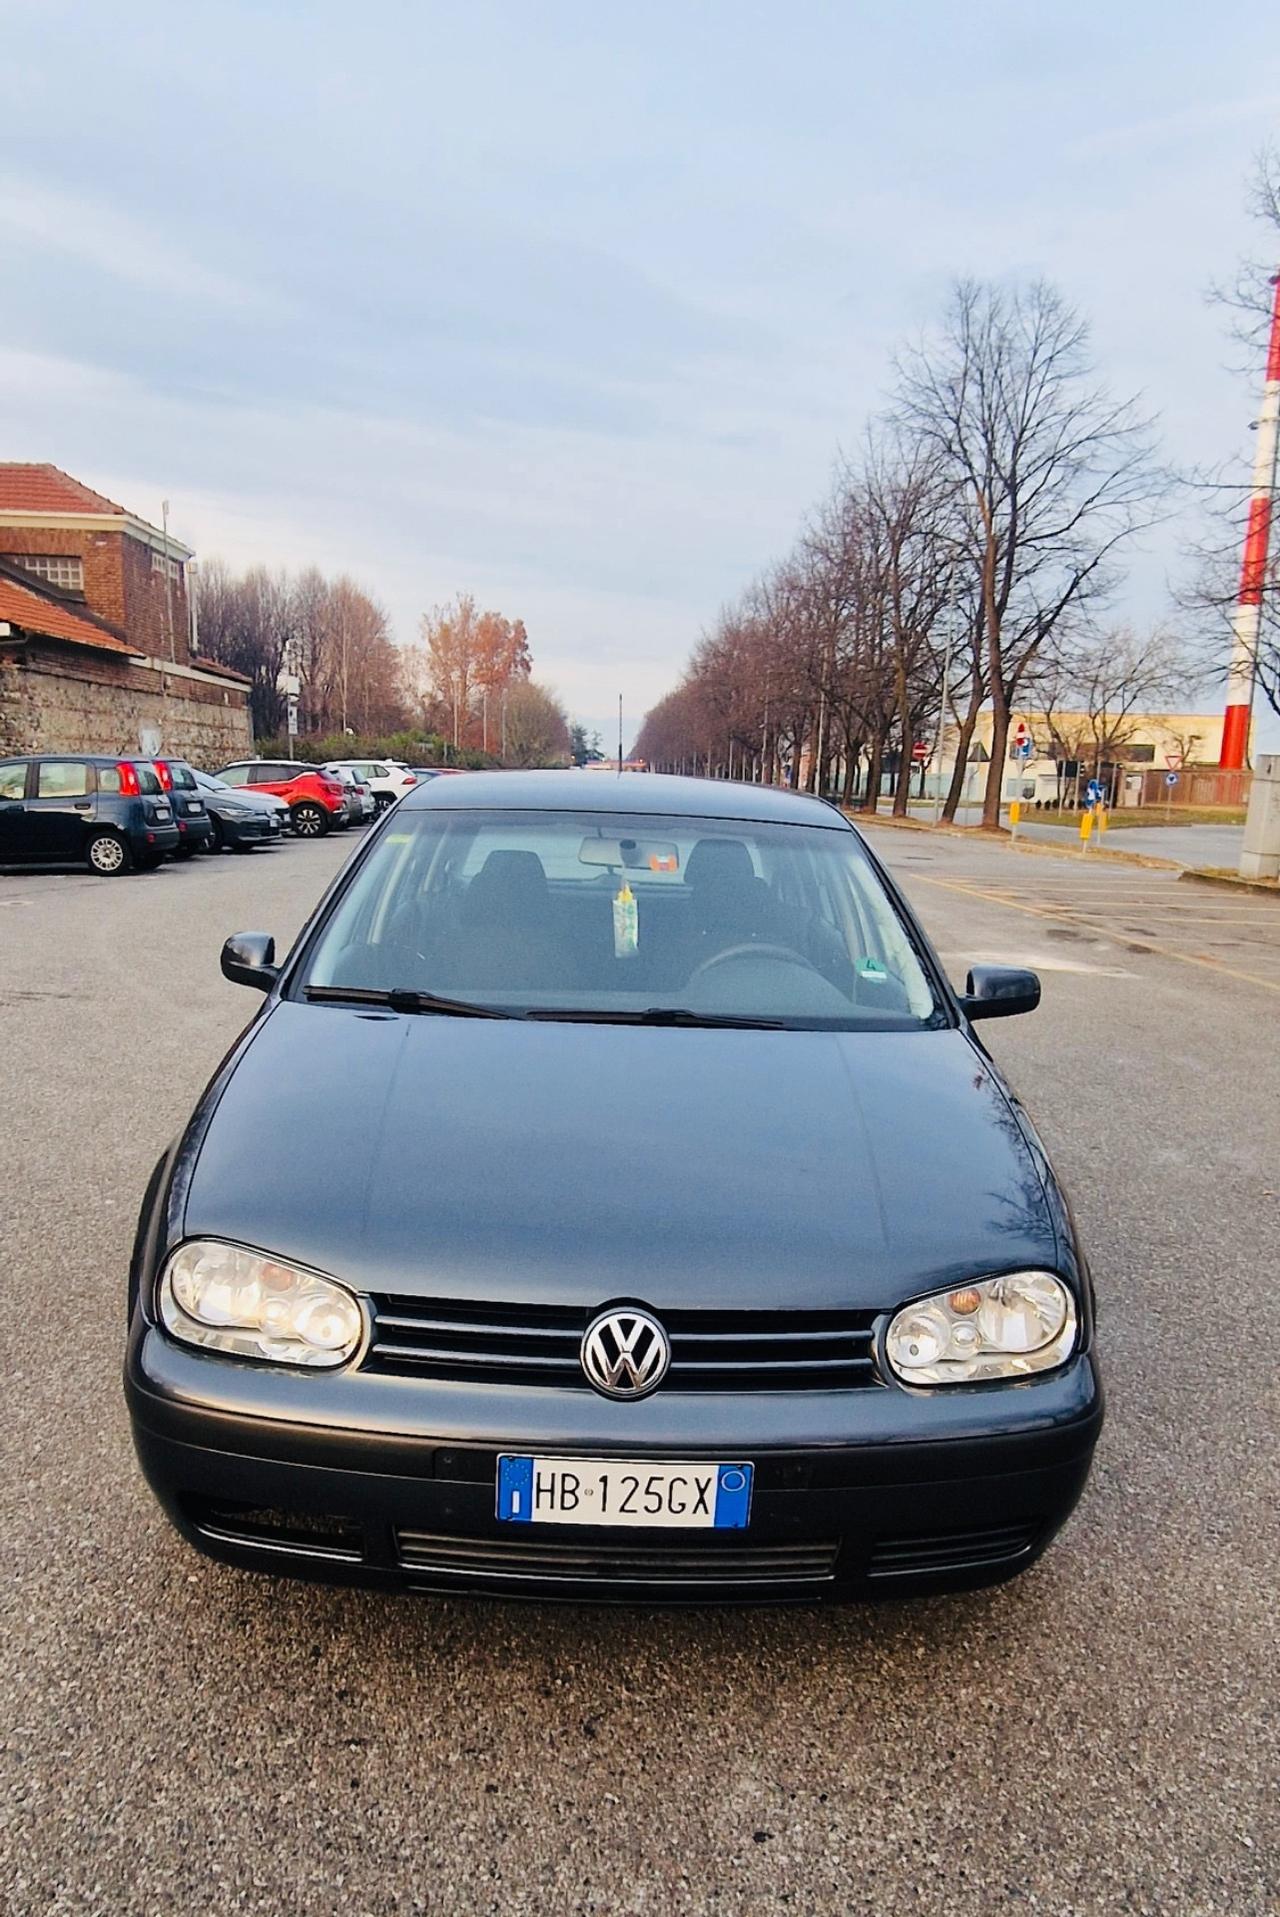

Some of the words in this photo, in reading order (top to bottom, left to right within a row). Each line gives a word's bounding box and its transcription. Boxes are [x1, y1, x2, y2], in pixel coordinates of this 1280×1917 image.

[585, 1312, 666, 1393] VW
[535, 1472, 580, 1511] HB
[599, 1475, 712, 1515] 125GX
